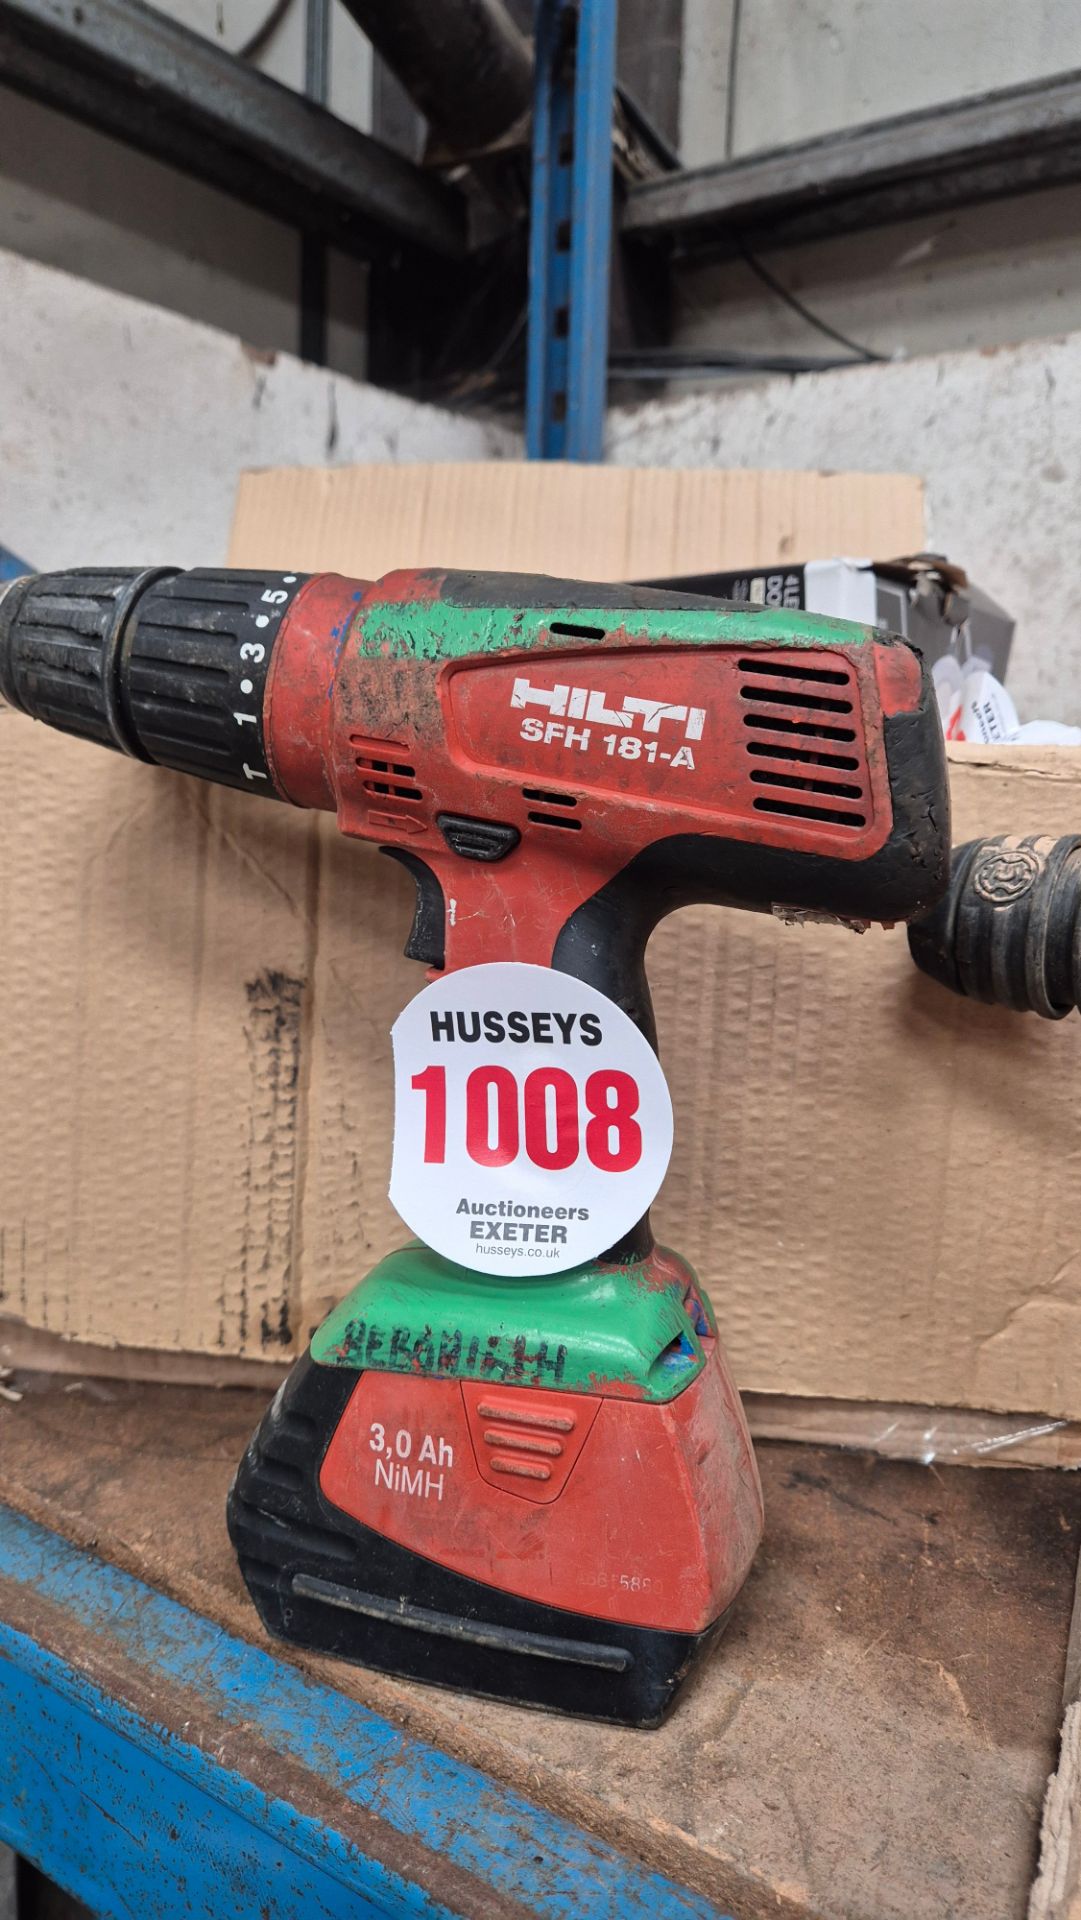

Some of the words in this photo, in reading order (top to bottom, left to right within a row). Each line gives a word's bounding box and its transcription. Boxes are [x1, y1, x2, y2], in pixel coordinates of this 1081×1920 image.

[261, 589, 288, 604] 5
[240, 642, 266, 663] 3
[233, 708, 258, 726] 1
[510, 678, 707, 741] HILTI
[519, 717, 591, 751] SFH
[603, 733, 696, 770] 181-A
[242, 763, 267, 780] T
[429, 1010, 603, 1047] HUSSEYS
[411, 1064, 643, 1173] 1008
[456, 1198, 590, 1221] Auctioneers
[469, 1220, 568, 1244] EXETER
[475, 1242, 561, 1259] husseys.co.uk
[369, 1422, 412, 1461] 3,0
[418, 1434, 454, 1467] Ah
[374, 1460, 444, 1500] NiMH
